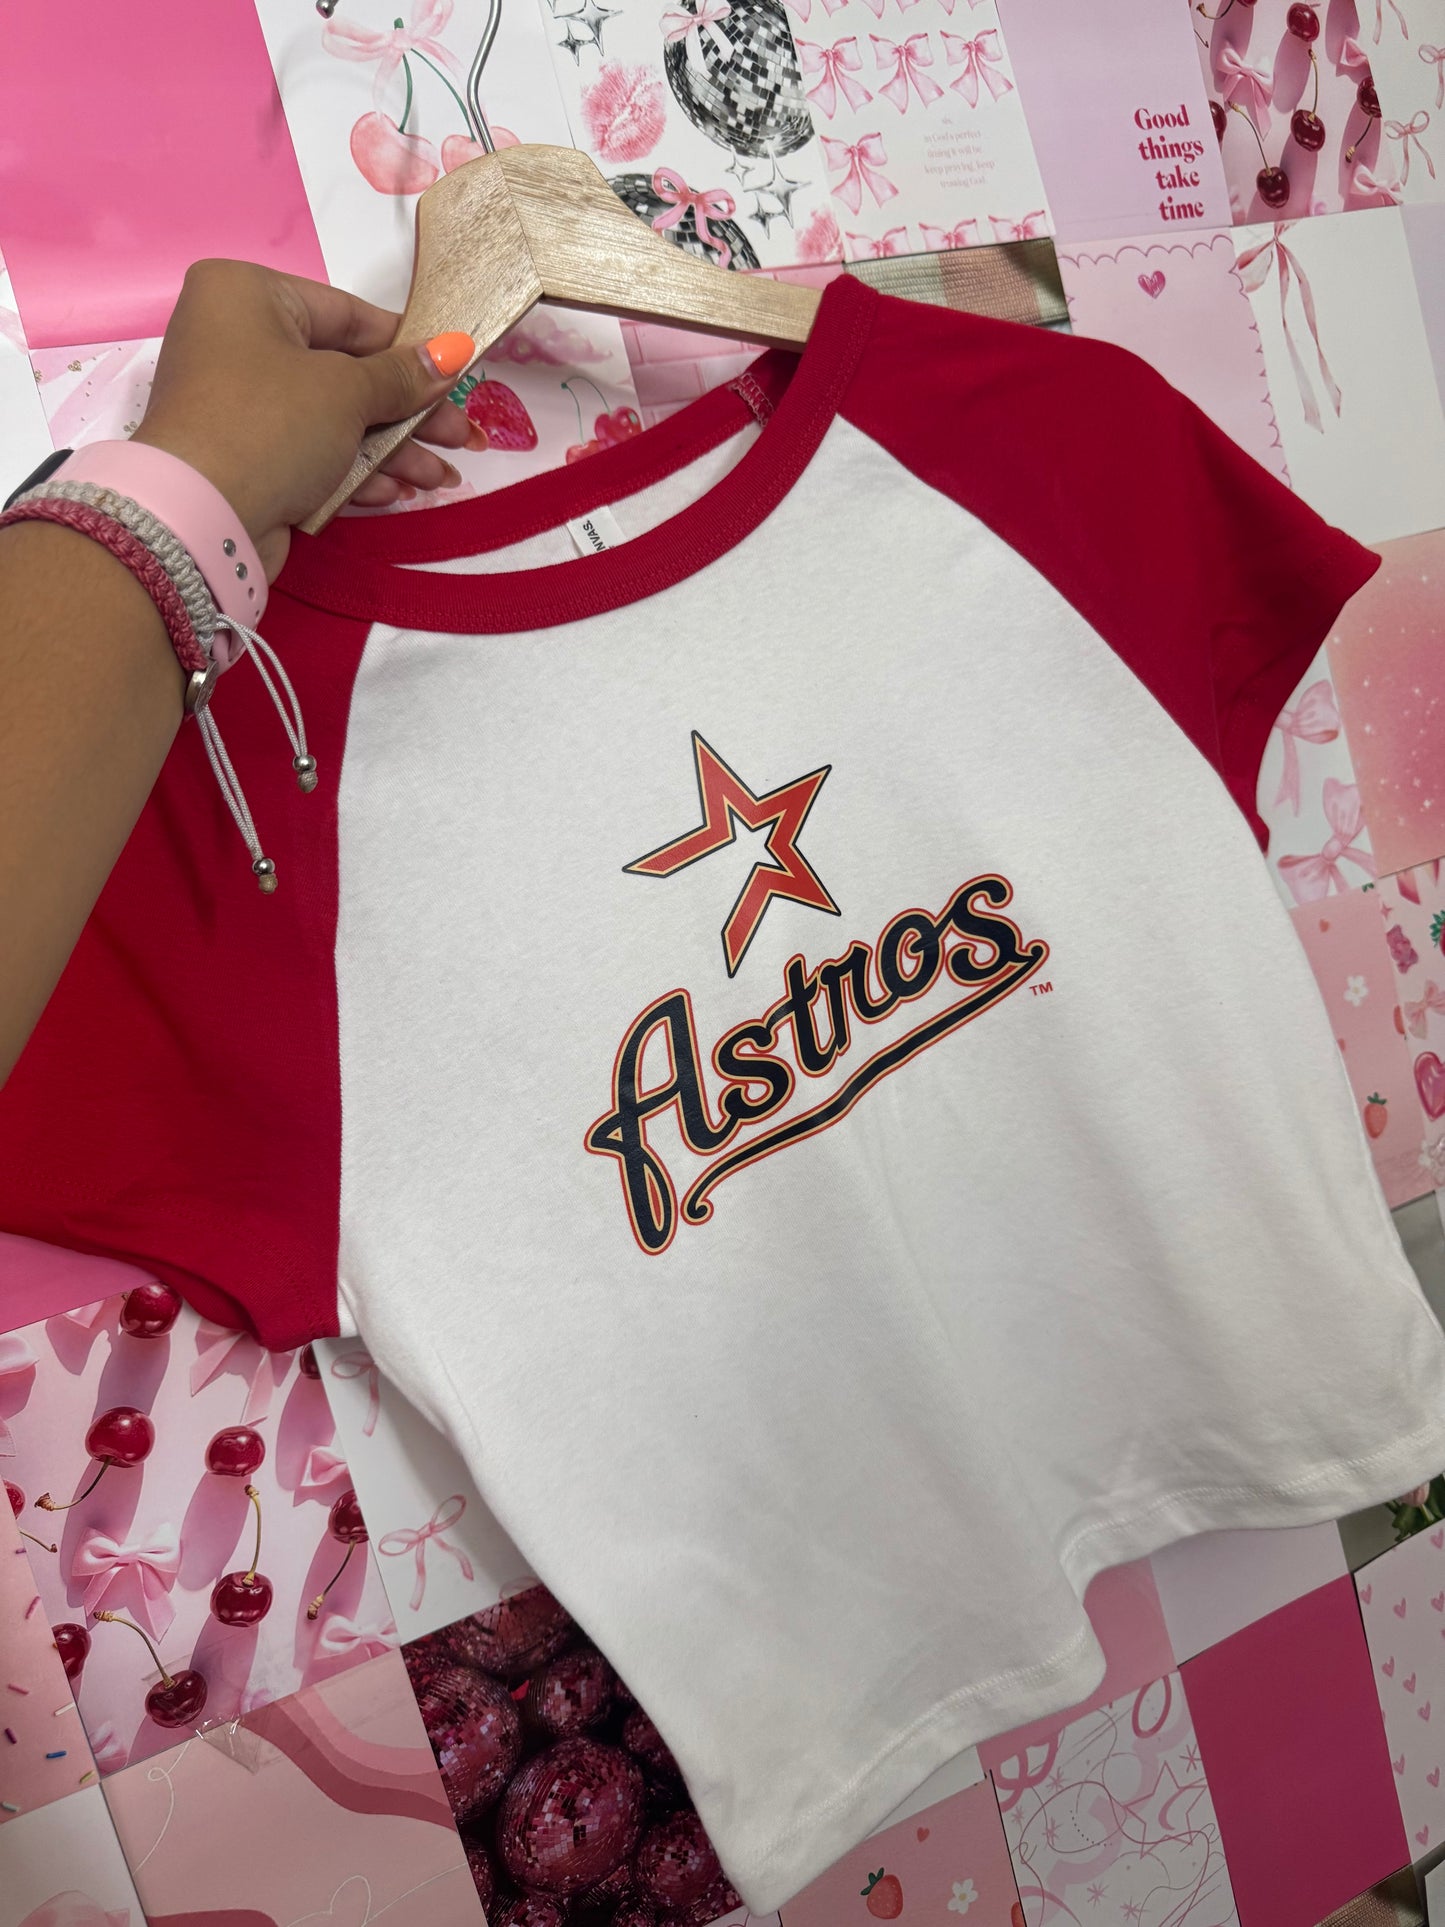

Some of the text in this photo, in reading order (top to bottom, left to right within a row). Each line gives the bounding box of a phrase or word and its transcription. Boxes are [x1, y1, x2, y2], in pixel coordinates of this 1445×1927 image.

[1134, 104, 1190, 131] Good
[954, 129, 982, 143] perfect
[1138, 135, 1204, 164] things
[1155, 165, 1201, 190] take
[1159, 195, 1204, 221] time
[1029, 981, 1054, 996] TM
[584, 873, 1050, 1256] Astros
